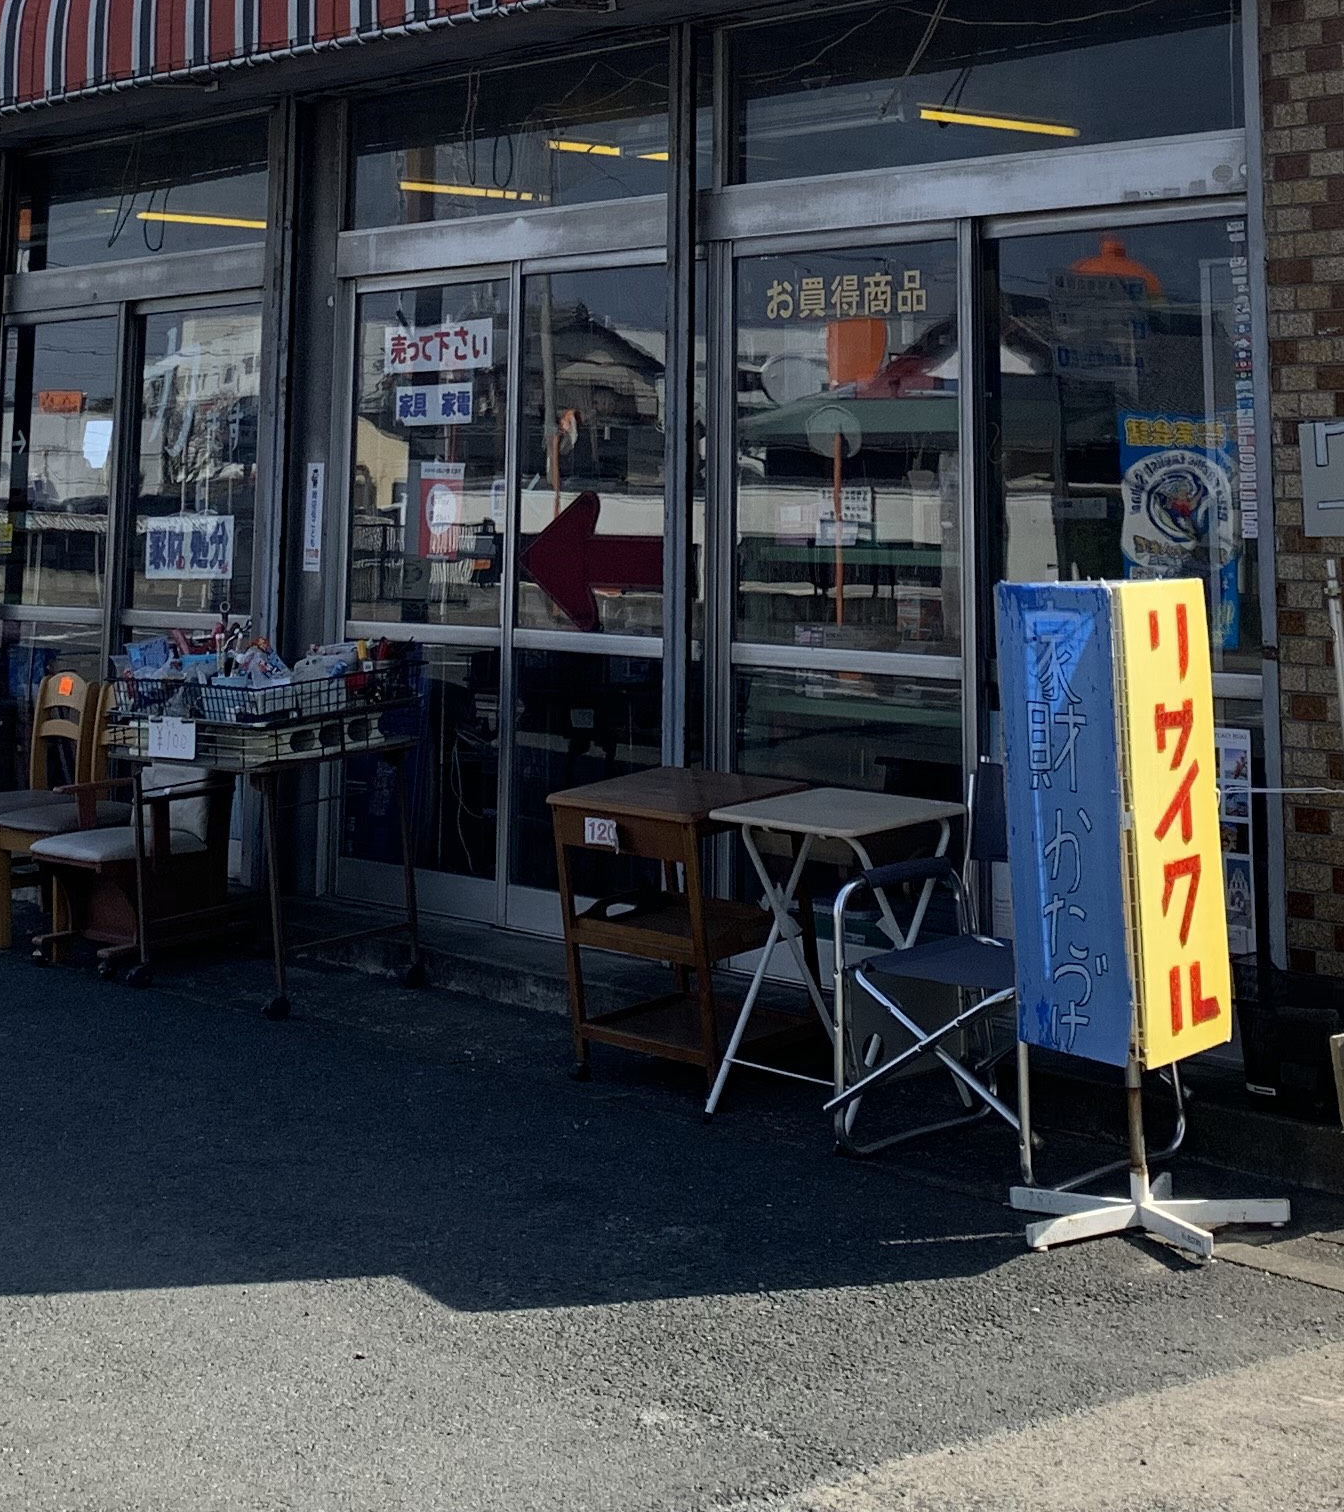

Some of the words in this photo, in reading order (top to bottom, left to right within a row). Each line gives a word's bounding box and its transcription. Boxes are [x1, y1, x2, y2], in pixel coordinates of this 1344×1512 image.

[766, 269, 927, 320] お買得商品
[390, 326, 488, 365] 売って下さい
[399, 392, 427, 419] 家具
[441, 390, 471, 417] 家電
[1148, 603, 1222, 1037] リサイクル
